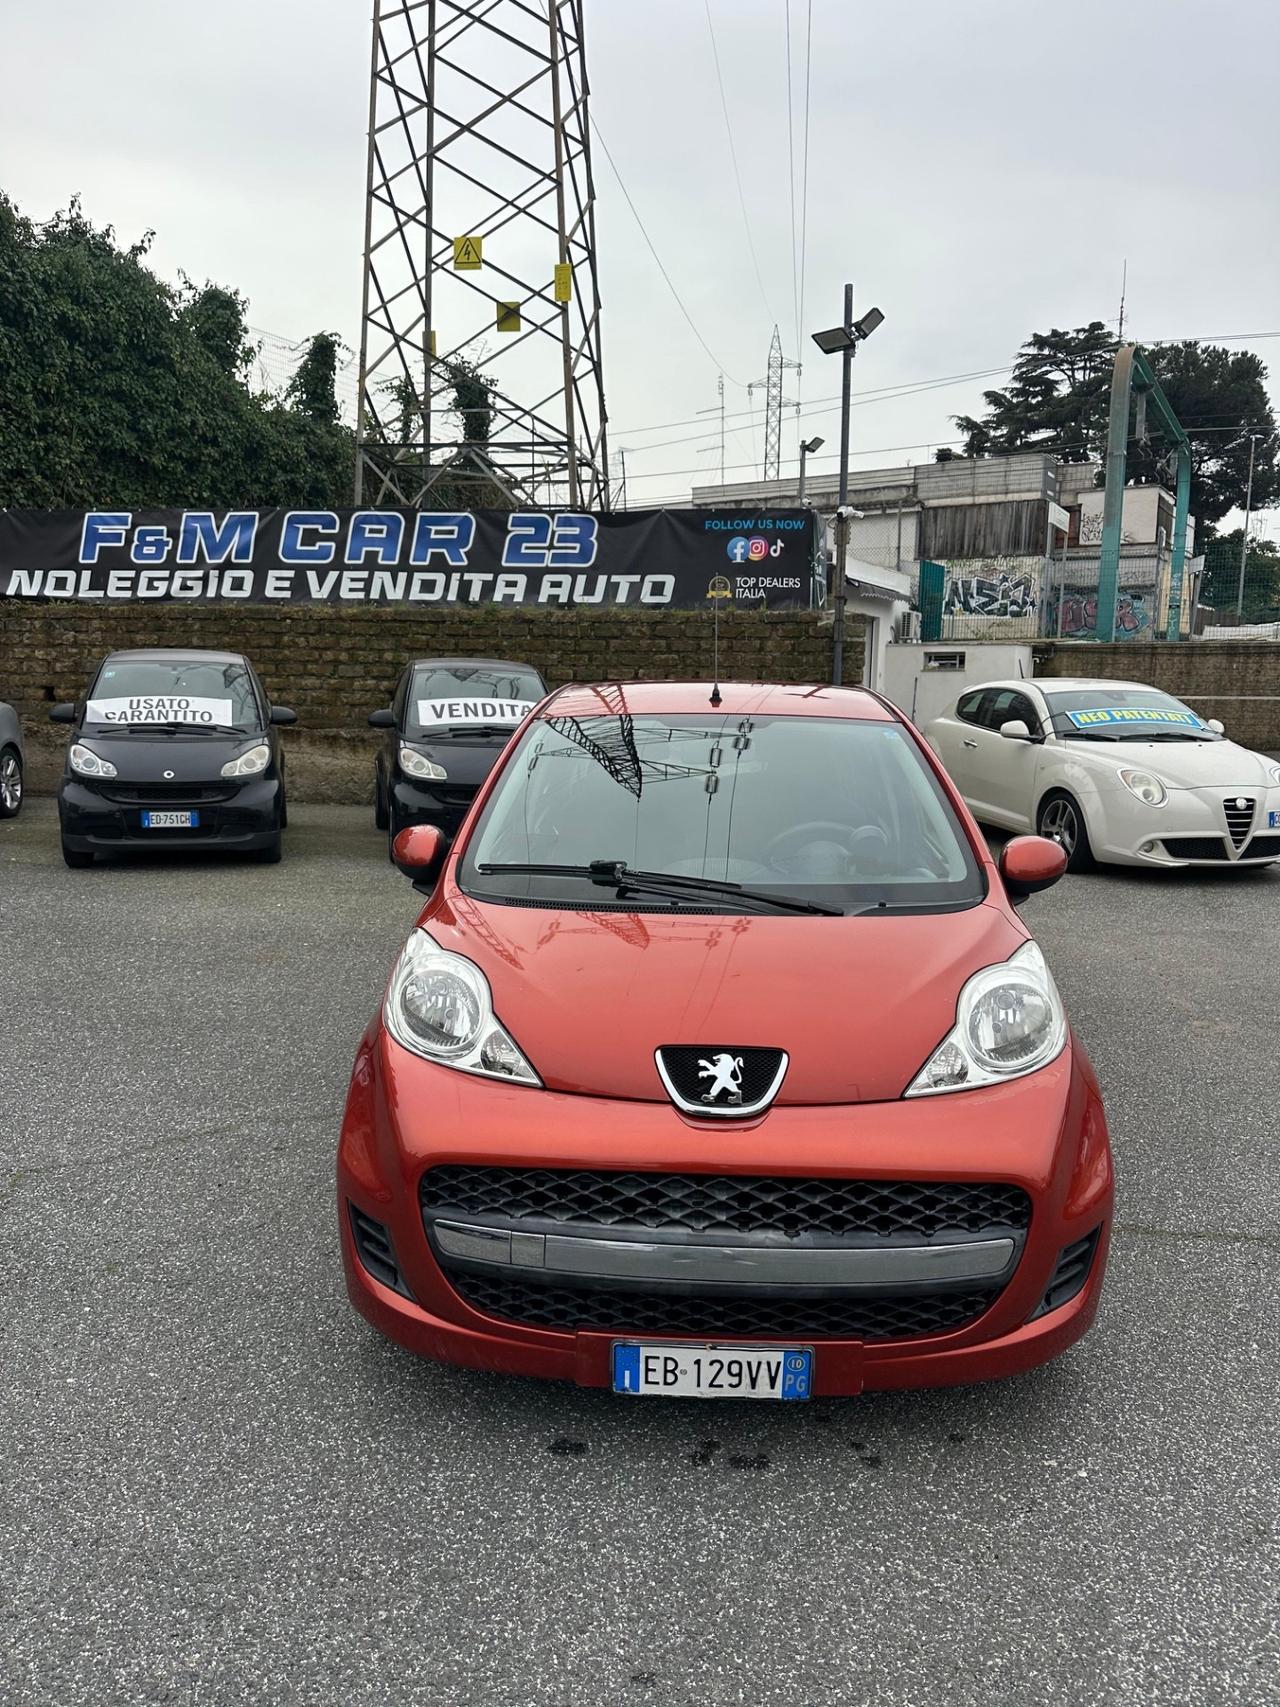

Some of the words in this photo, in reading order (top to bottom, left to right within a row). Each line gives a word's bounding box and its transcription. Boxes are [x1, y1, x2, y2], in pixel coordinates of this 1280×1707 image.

[705, 520, 755, 530] FOLLOW
[758, 520, 773, 529] US
[776, 520, 805, 530] NOW
[79, 511, 259, 564] F&M
[278, 511, 476, 565] CAR
[502, 513, 599, 567] 23
[6, 569, 255, 599] NOLEGGIO
[265, 570, 296, 599] E
[305, 571, 527, 602] VENDITA
[537, 574, 676, 603] AUTO
[735, 577, 757, 588] TOP
[758, 577, 801, 589] DEALERS
[735, 588, 767, 599] ITALIA
[129, 698, 190, 710] USATO
[431, 702, 531, 719] VENDITA
[1076, 710, 1108, 724] NEO
[1112, 710, 1193, 725] PATENTATI
